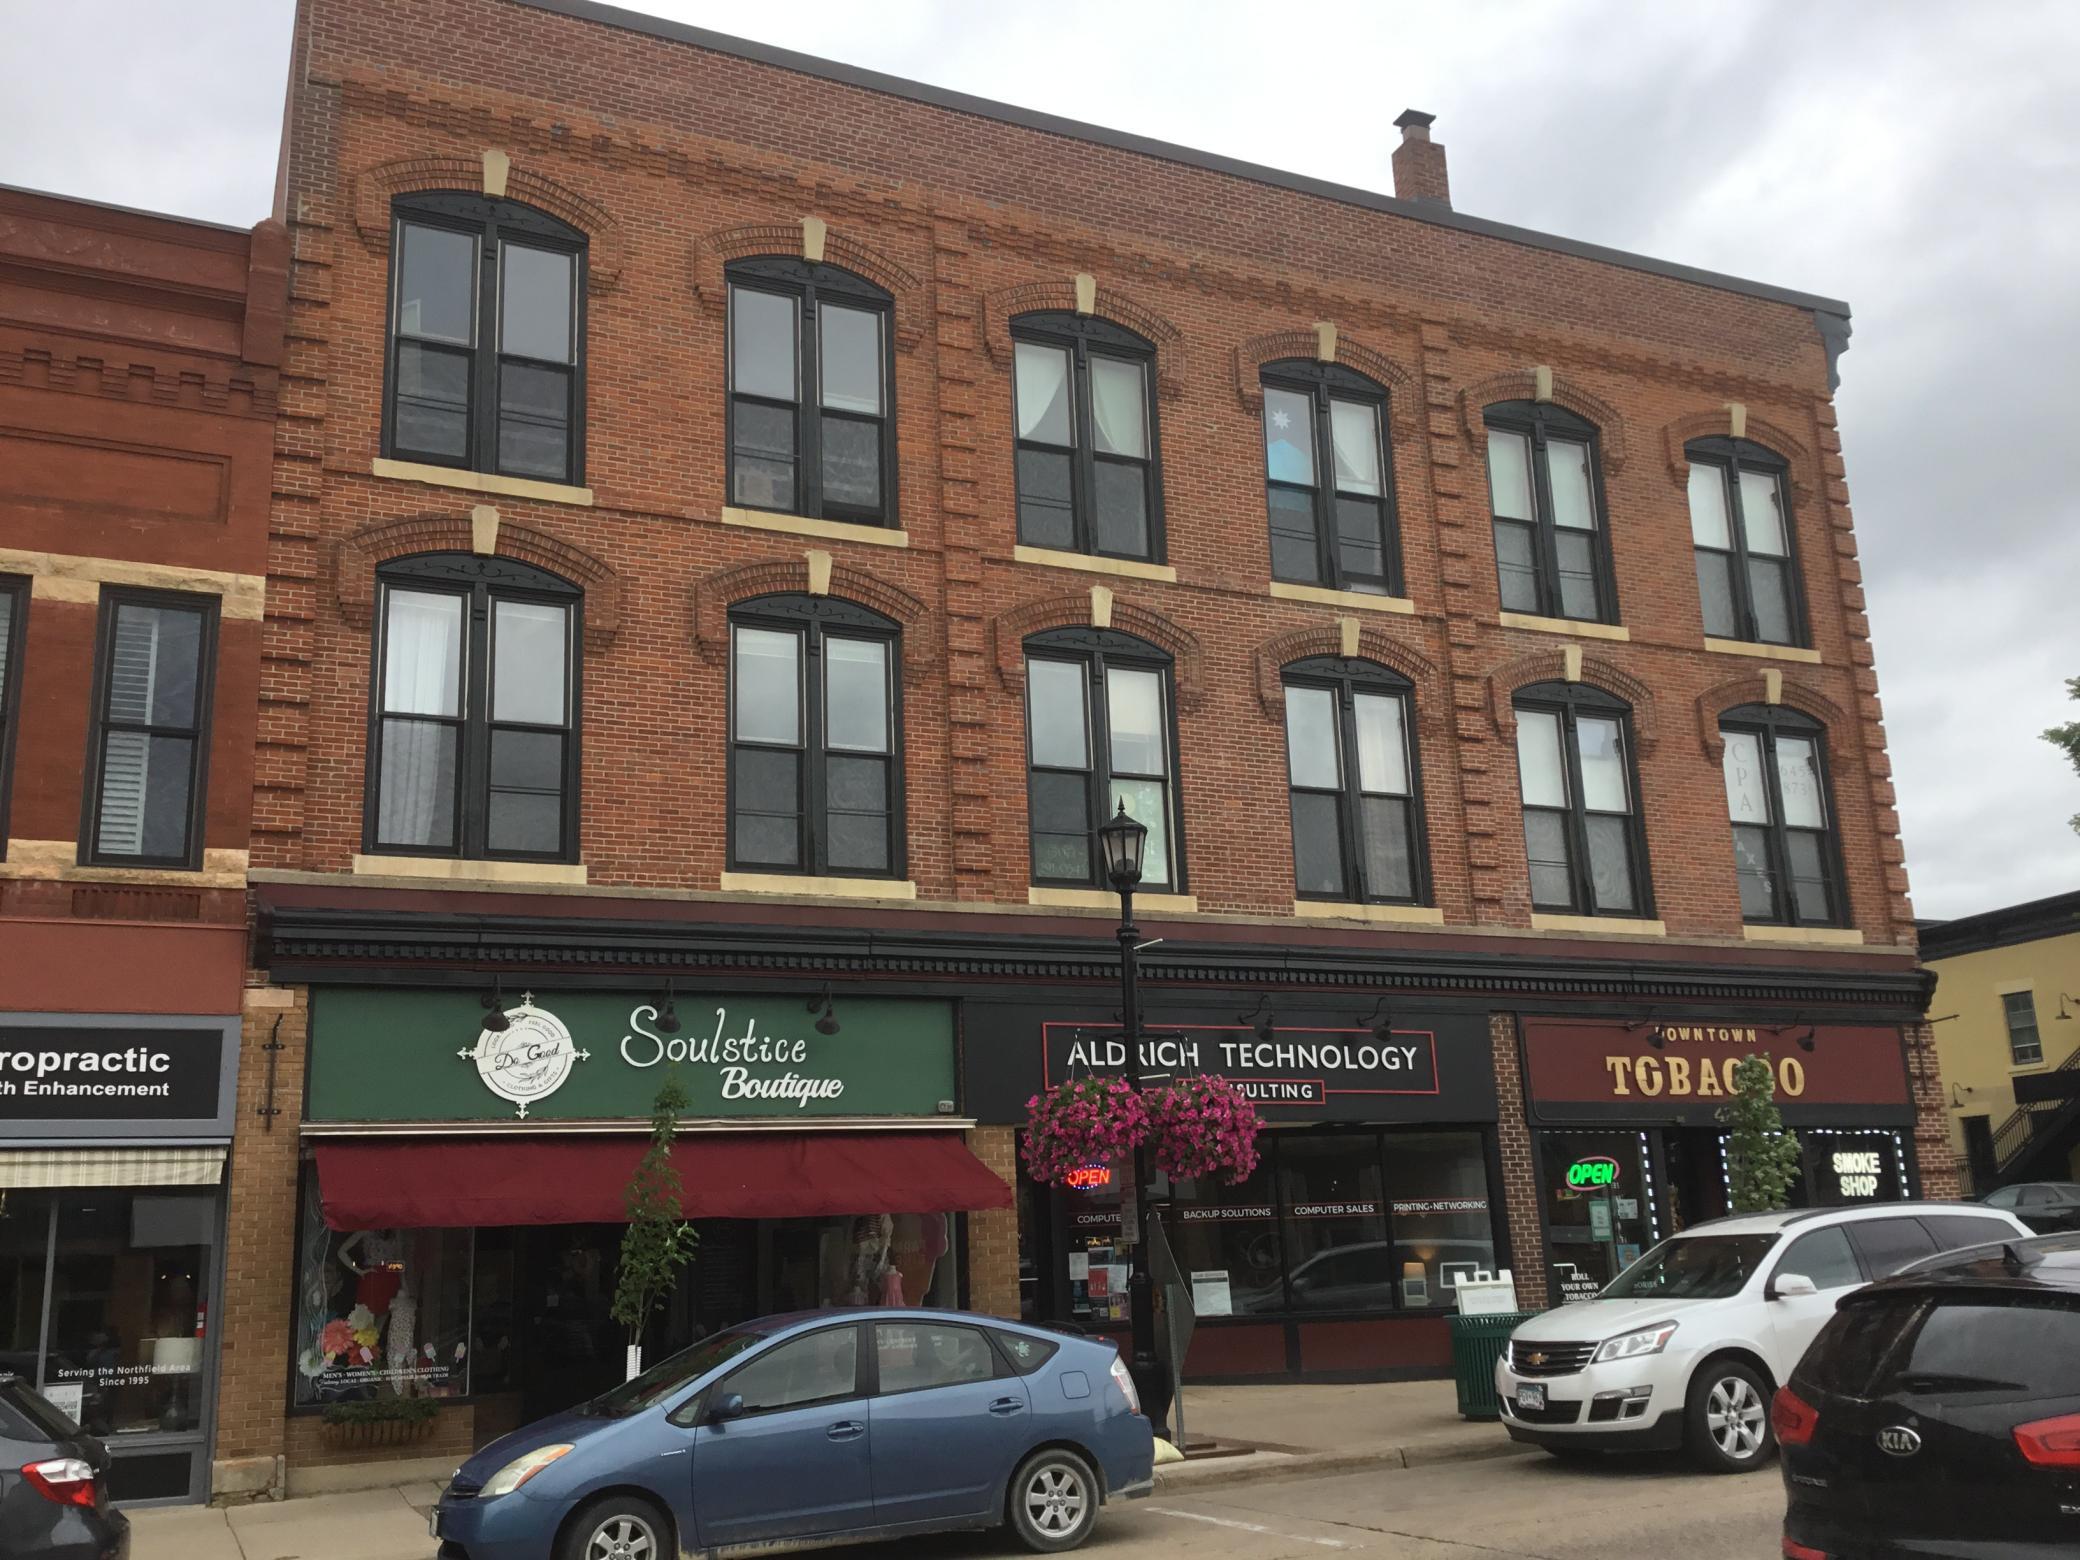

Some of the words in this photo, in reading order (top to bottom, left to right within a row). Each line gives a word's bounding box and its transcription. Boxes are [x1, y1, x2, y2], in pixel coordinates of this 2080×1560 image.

[620, 1005, 806, 1067] Soulstice
[1655, 1026, 1756, 1042] OWNTOWN
[527, 1042, 559, 1061] Good
[1219, 1043, 1417, 1070] TECHNOLOGY
[1605, 1055, 1805, 1097] TOBACO
[24, 1081, 169, 1096] Enhancement
[720, 1066, 844, 1108] Boutique
[1833, 1152, 1881, 1174] SMOKE
[1067, 1169, 1110, 1186] OPEN
[1569, 1163, 1614, 1184] OPEN
[1840, 1175, 1877, 1197] SHOP
[1183, 1210, 1220, 1220] BACKUP
[1221, 1208, 1271, 1218] SOLUTIONS
[1294, 1206, 1343, 1215] COMPUTER
[1346, 1204, 1374, 1213] SALES
[1077, 1214, 1122, 1224] COMPUTE
[1571, 1273, 1590, 1281] ROLL
[1561, 1283, 1580, 1291] YOUR
[1581, 1282, 1599, 1290] OWN
[1564, 1292, 1598, 1301] TOBACCO
[58, 1368, 95, 1378] Serving
[98, 1367, 114, 1375] the
[117, 1364, 166, 1375] Northfield
[169, 1364, 191, 1373] Area
[99, 1378, 125, 1387] Since
[129, 1376, 150, 1385] 1995
[1881, 1432, 1914, 1450] KIA
